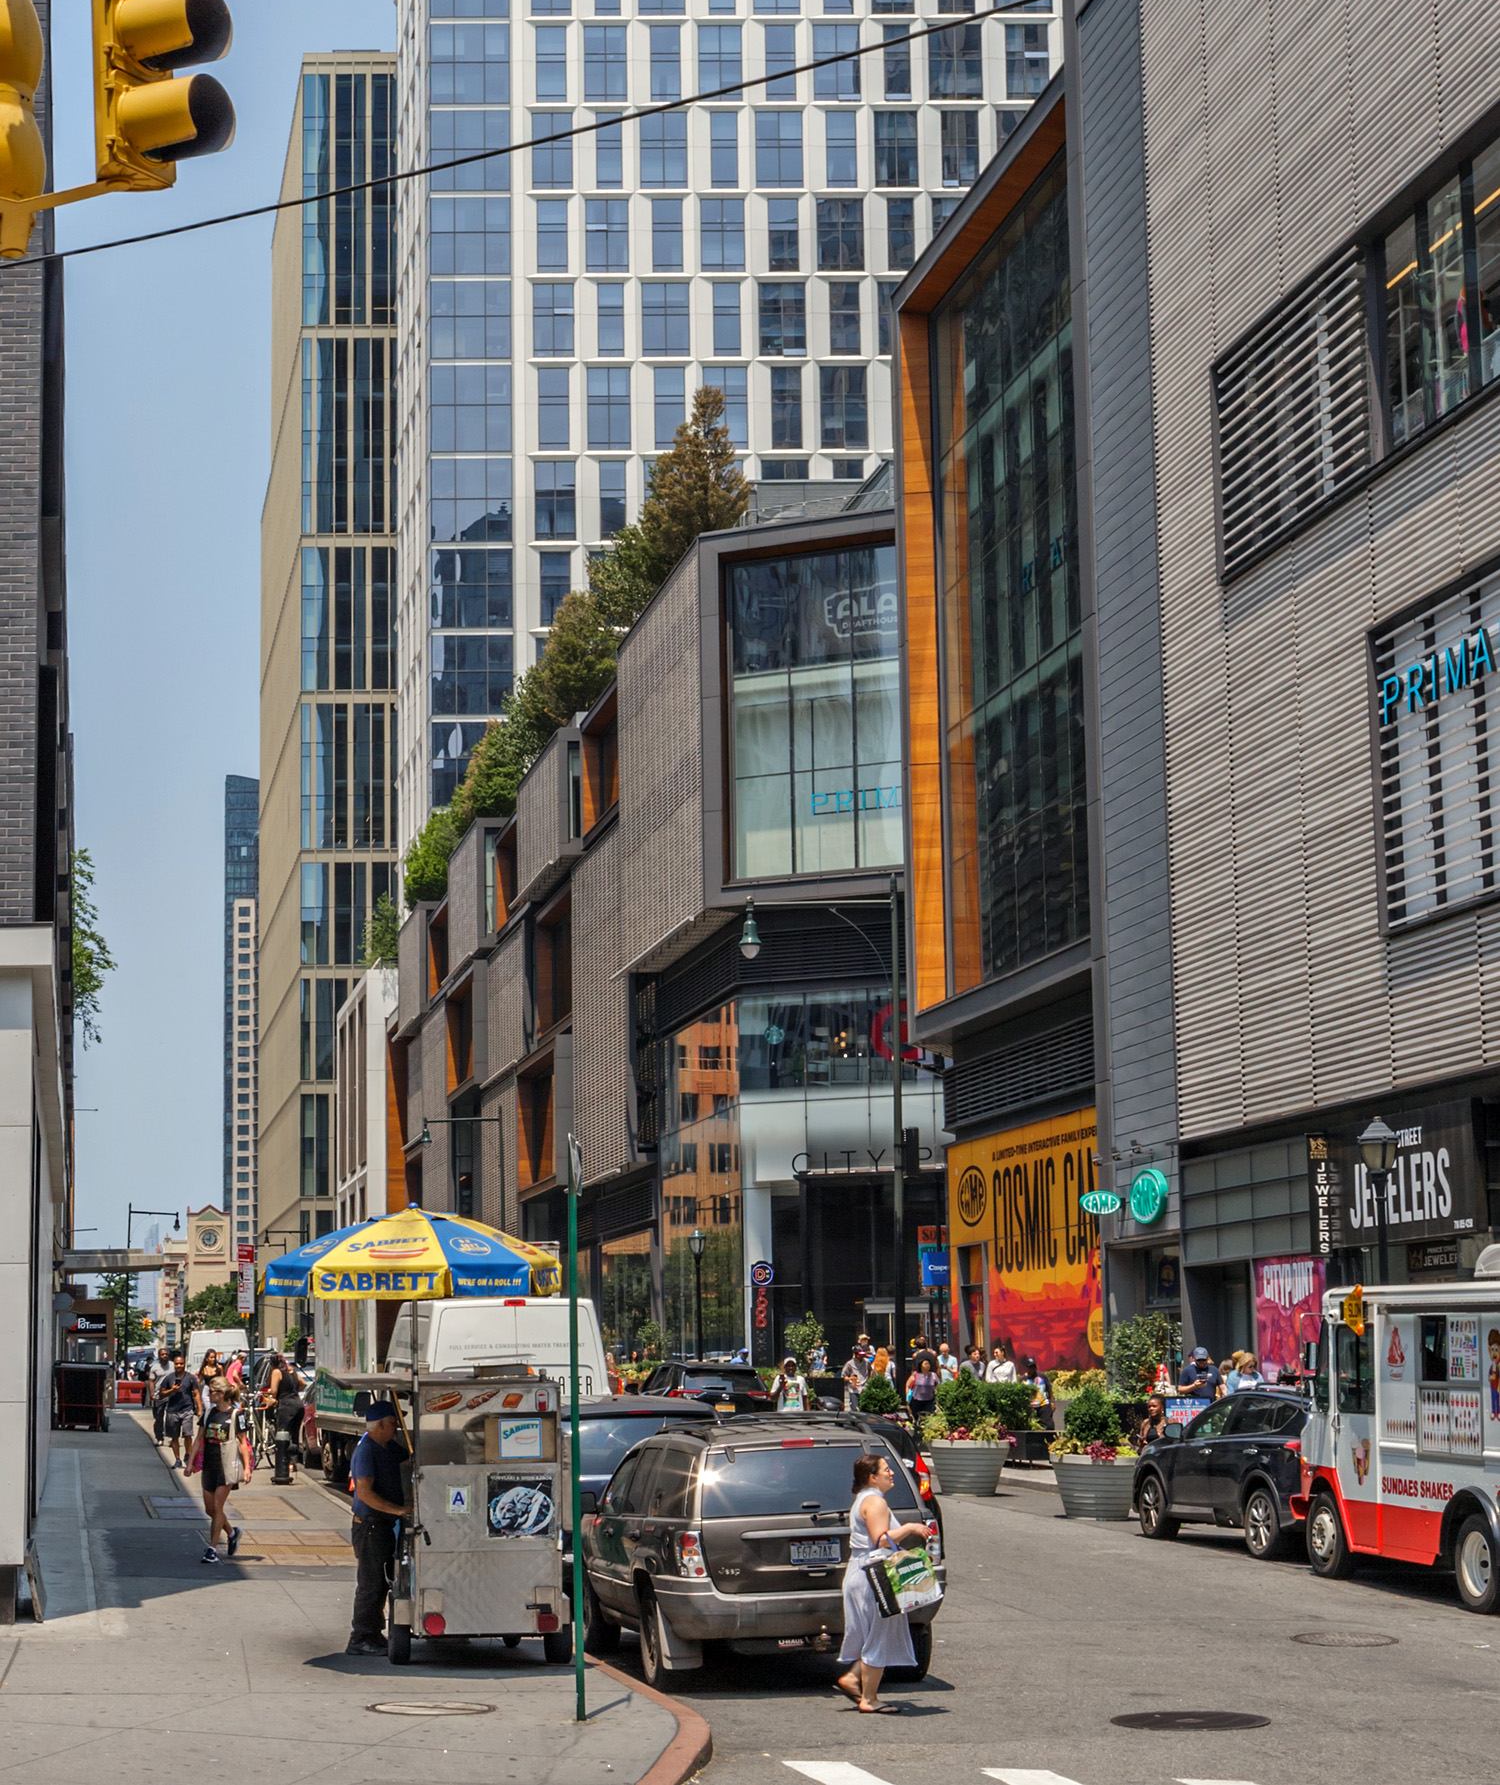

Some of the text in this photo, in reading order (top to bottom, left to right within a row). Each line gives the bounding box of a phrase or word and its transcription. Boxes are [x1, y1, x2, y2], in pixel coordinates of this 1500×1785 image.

[811, 785, 898, 816] PRIM
[997, 1143, 1028, 1161] LIMITED-TIME
[1028, 1134, 1060, 1153] INTERACTIVE
[1061, 1127, 1081, 1145] FAMILY
[792, 1149, 886, 1174] CITY
[1350, 1147, 1452, 1229] JEELERS
[993, 1157, 1057, 1274] COSMIC
[1085, 1194, 1118, 1214] CAMP
[1315, 1162, 1330, 1253] JEWELERS
[346, 1237, 429, 1253] SABRETT
[320, 1272, 439, 1292] SABRETT
[494, 1278, 511, 1286] ROLL
[503, 1423, 539, 1439] SABRETT
[452, 1491, 465, 1506] A
[1382, 1476, 1453, 1501] SUNDAES SHAKES
